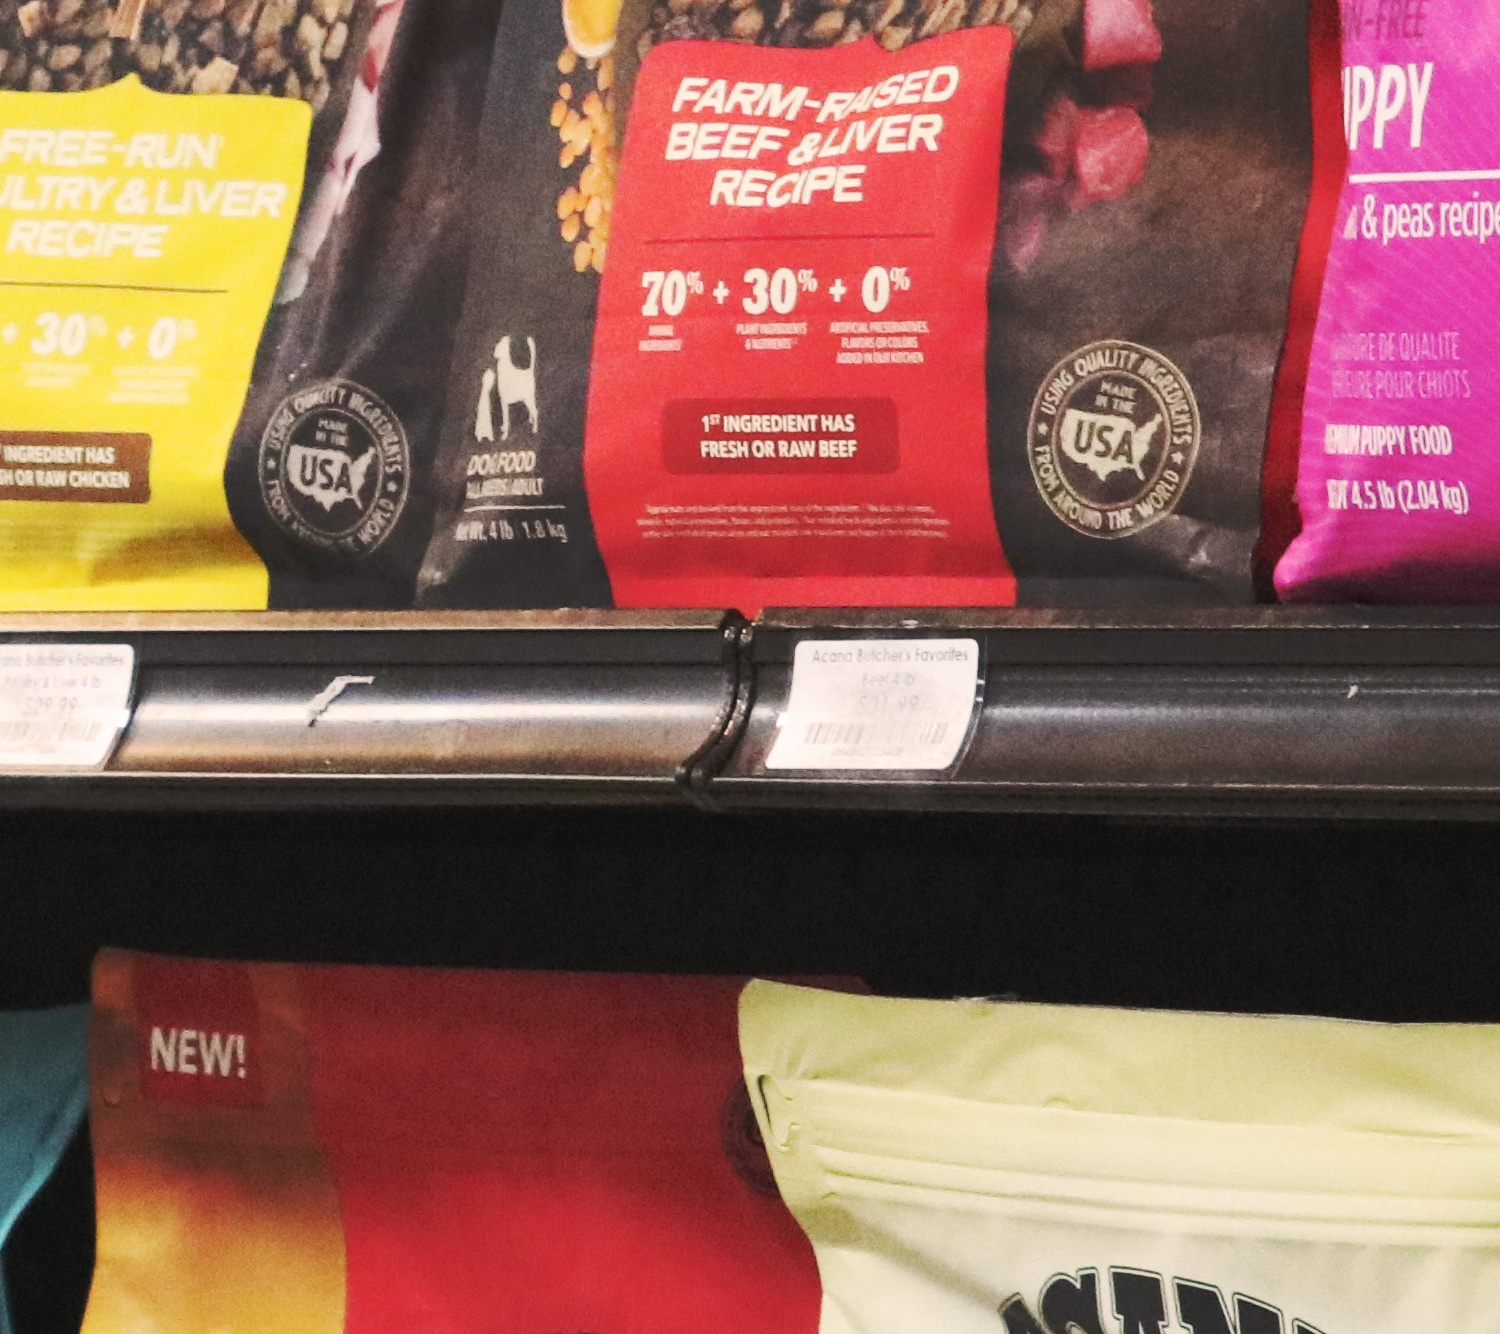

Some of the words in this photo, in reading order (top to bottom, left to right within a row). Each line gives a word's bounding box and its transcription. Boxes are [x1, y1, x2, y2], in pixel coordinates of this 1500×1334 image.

[672, 65, 960, 120] FARM-RAISED
[664, 122, 794, 164] BEEF
[792, 131, 820, 167] &
[819, 113, 944, 156] LIVER
[115, 180, 148, 215] &
[153, 178, 287, 218] LIVER
[710, 164, 867, 208] RECIPE
[6, 219, 169, 259] RECIPE
[1361, 201, 1378, 238] &
[1383, 198, 1435, 245] peas
[641, 269, 704, 317] 70%
[742, 268, 817, 316] 30%
[861, 266, 910, 313] 0%
[723, 415, 818, 433] INGREDIENT
[821, 414, 856, 433] HAS
[1074, 420, 1135, 463] USA
[1409, 424, 1453, 455] FOOD
[2, 444, 81, 465] INGREDIENT
[84, 446, 115, 466] HAS
[700, 440, 749, 458] FRESH
[751, 440, 776, 458] OR
[779, 440, 816, 458] RAW
[818, 440, 858, 458] BEEF
[14, 468, 34, 487] OR
[36, 469, 66, 488] RAW
[68, 469, 130, 490] CHICKEN
[1351, 479, 1376, 509] 4.5
[1379, 479, 1396, 508] lb
[1398, 479, 1439, 514] (2.04
[1441, 479, 1470, 515] kg)
[151, 1028, 248, 1078] NEW!
